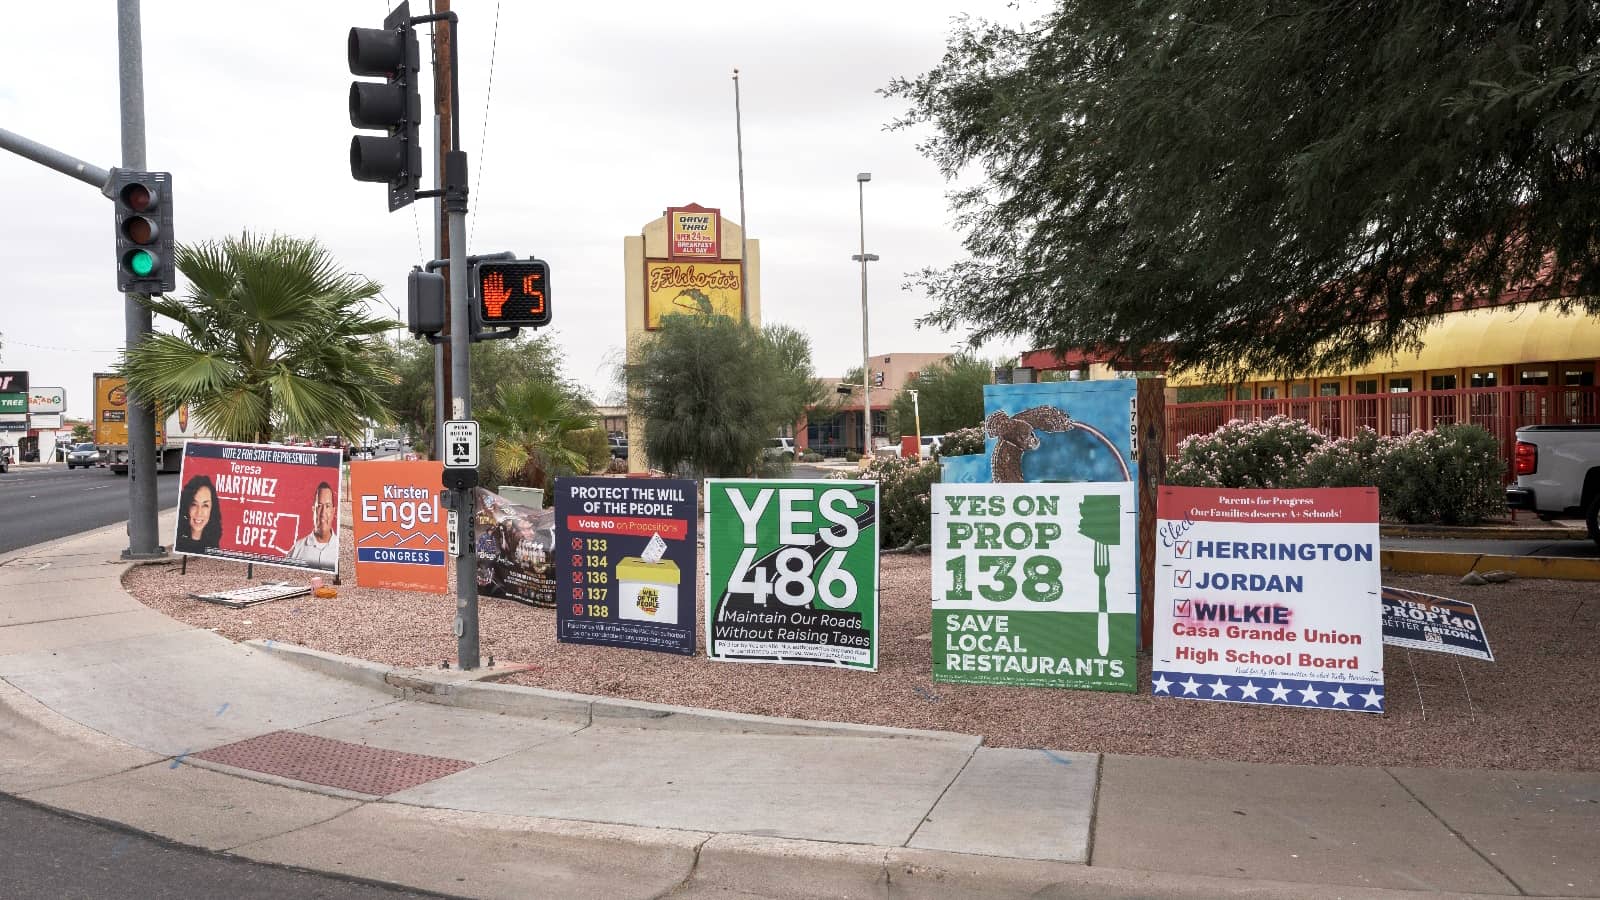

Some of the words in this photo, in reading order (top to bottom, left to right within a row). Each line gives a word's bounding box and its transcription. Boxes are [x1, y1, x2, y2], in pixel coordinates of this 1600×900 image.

[692, 232, 701, 240] 24
[651, 265, 739, 292] Filiberto's
[523, 274, 544, 314] 5
[222, 448, 237, 458] VOTE
[237, 449, 241, 459] 2
[242, 449, 253, 460] FOR
[254, 450, 272, 462] STATE
[272, 452, 318, 465] REPRESENTATIVE
[231, 462, 262, 474] Teresa
[216, 474, 278, 497] MARTINEZ
[384, 486, 428, 500] Kirsten
[570, 486, 630, 499] PROTECT
[632, 488, 654, 500] THE
[657, 489, 684, 501] WILL
[584, 502, 600, 514] OF
[604, 502, 626, 514] THE
[630, 504, 672, 516] PEOPLE
[945, 496, 1006, 516] YES
[1013, 495, 1060, 516] ON
[1219, 496, 1255, 505] Parents
[1257, 497, 1271, 505] for
[1272, 497, 1314, 508] Progress
[244, 510, 278, 528] CHRIS
[362, 496, 438, 529] Engel
[725, 488, 858, 548] YES
[1190, 508, 1210, 516] Our
[1210, 508, 1250, 518] Families
[1250, 510, 1287, 518] deserve
[1290, 510, 1302, 518] A+
[1302, 510, 1342, 518] Schools!
[578, 520, 600, 528] Vote
[601, 521, 614, 529] NO
[1160, 511, 1195, 548] Elect
[236, 526, 277, 548] LOPEZ
[586, 540, 608, 552] 133
[946, 522, 1062, 550] PROP
[374, 550, 430, 563] CONGRESS
[1196, 540, 1373, 562] HERRINGTON
[586, 556, 608, 568] 134
[586, 572, 608, 584] 136
[728, 548, 858, 608] 486
[945, 555, 1064, 602] 138
[1196, 572, 1304, 593] JORDAN
[586, 588, 608, 600] 137
[587, 604, 608, 618] 138
[1194, 602, 1289, 624] WILKIE
[1382, 604, 1438, 622] PROP
[1440, 614, 1476, 630] 140
[1398, 600, 1426, 611] YES
[1430, 606, 1450, 616] ON
[724, 610, 786, 624] Maintain
[790, 612, 818, 624] Our
[820, 614, 862, 628] Roads
[946, 614, 1008, 634] SAVE
[716, 626, 774, 639] Without
[778, 628, 828, 645] Raising
[832, 631, 870, 646] Taxes
[946, 634, 1027, 653] LOCAL
[1172, 622, 1220, 638] Casa
[1226, 626, 1296, 642] Grande
[1304, 628, 1362, 645] Union
[946, 654, 1124, 678] RESTAURANTS
[1176, 646, 1219, 664] High
[1226, 649, 1291, 666] School
[1298, 653, 1359, 670] Board
